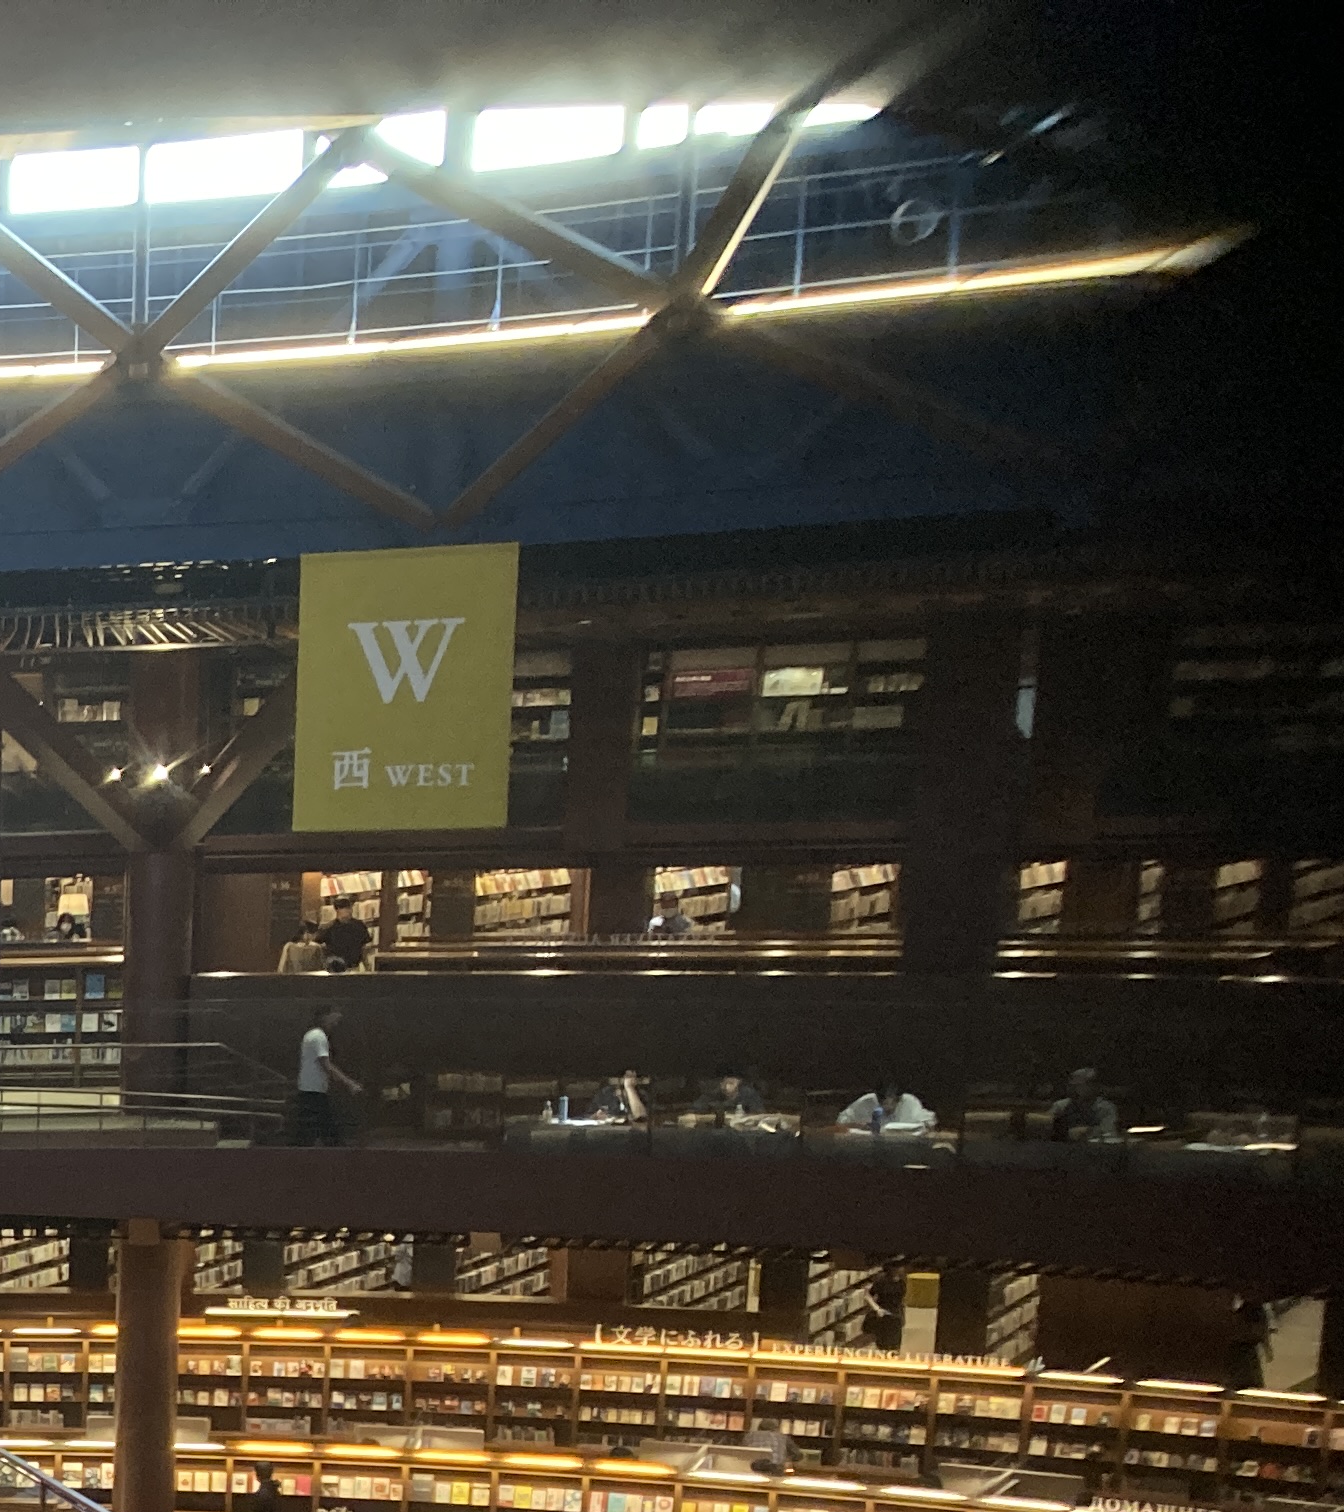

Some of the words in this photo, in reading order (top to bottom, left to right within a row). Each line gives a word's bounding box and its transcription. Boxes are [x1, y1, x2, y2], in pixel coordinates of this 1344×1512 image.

[348, 618, 465, 704] W
[332, 748, 372, 790] 西
[384, 763, 475, 787] WEST
[595, 1323, 760, 1353] 【文学にふれる】
[772, 1342, 899, 1361] EXPERIENCING
[905, 1351, 1010, 1368] LITERATURE
